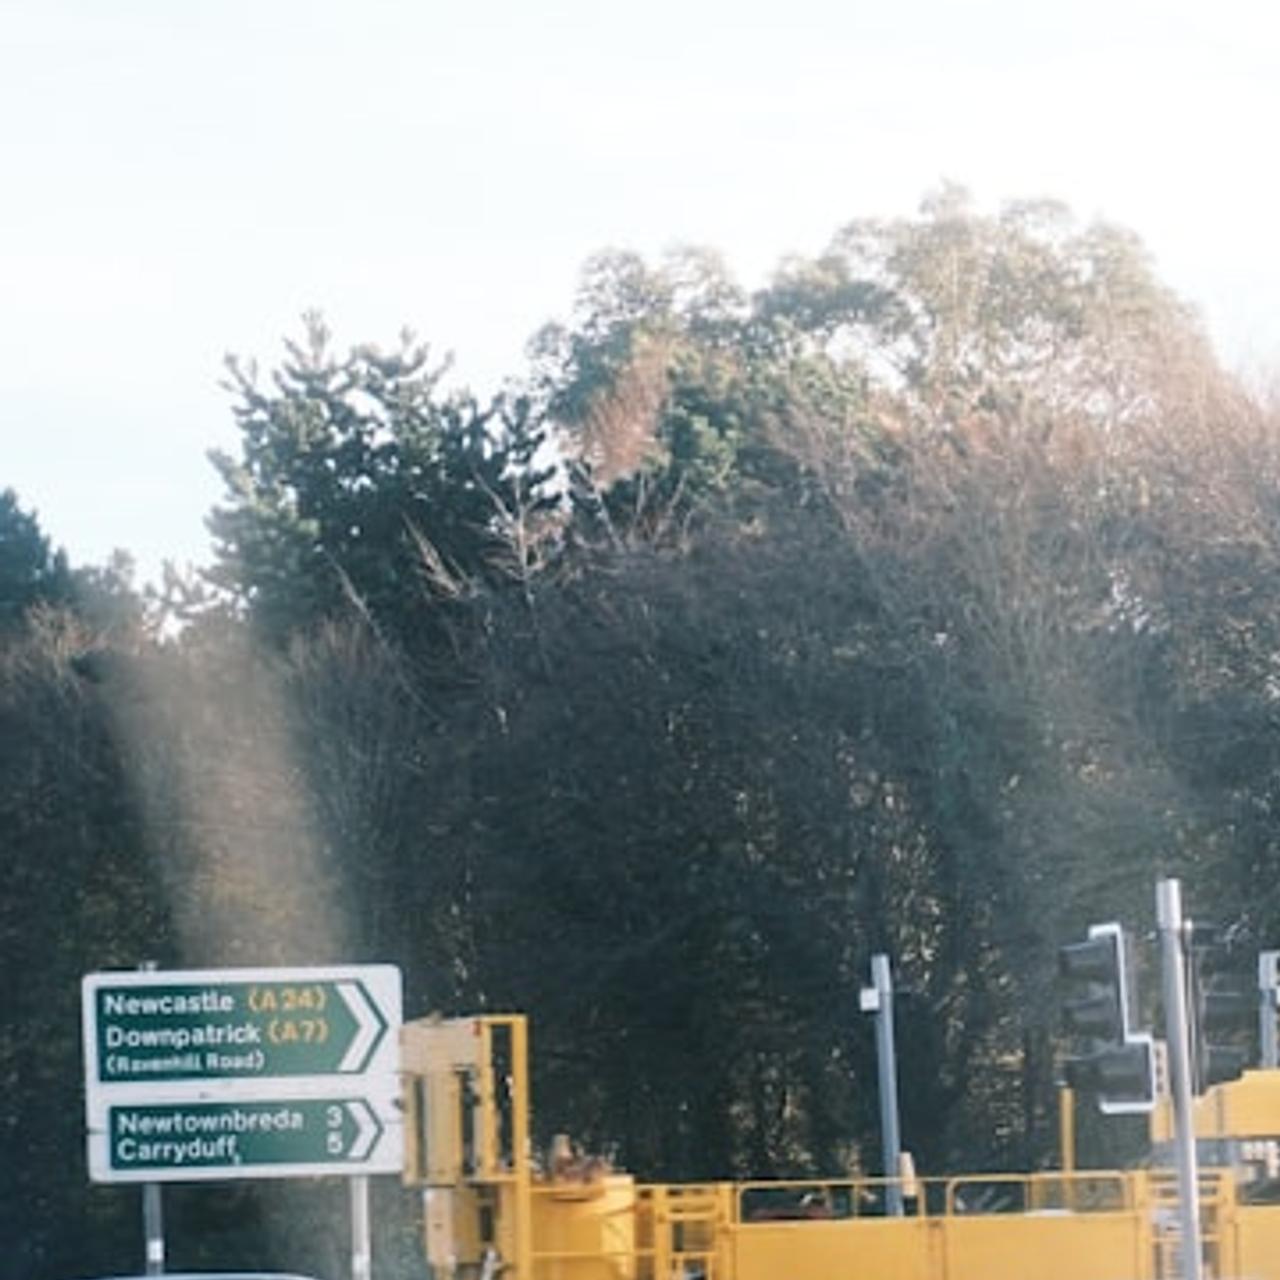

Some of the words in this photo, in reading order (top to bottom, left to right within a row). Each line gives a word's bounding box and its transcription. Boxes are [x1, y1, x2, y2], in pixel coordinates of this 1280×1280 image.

[105, 991, 235, 1015] Newcastle
[106, 1024, 261, 1048] Downpatrick
[267, 1017, 329, 1045] (A7)
[117, 1109, 303, 1134] Newtownbreda
[326, 1106, 343, 1129] 3
[117, 1138, 237, 1161] Carryduff
[327, 1132, 343, 1153] 5
